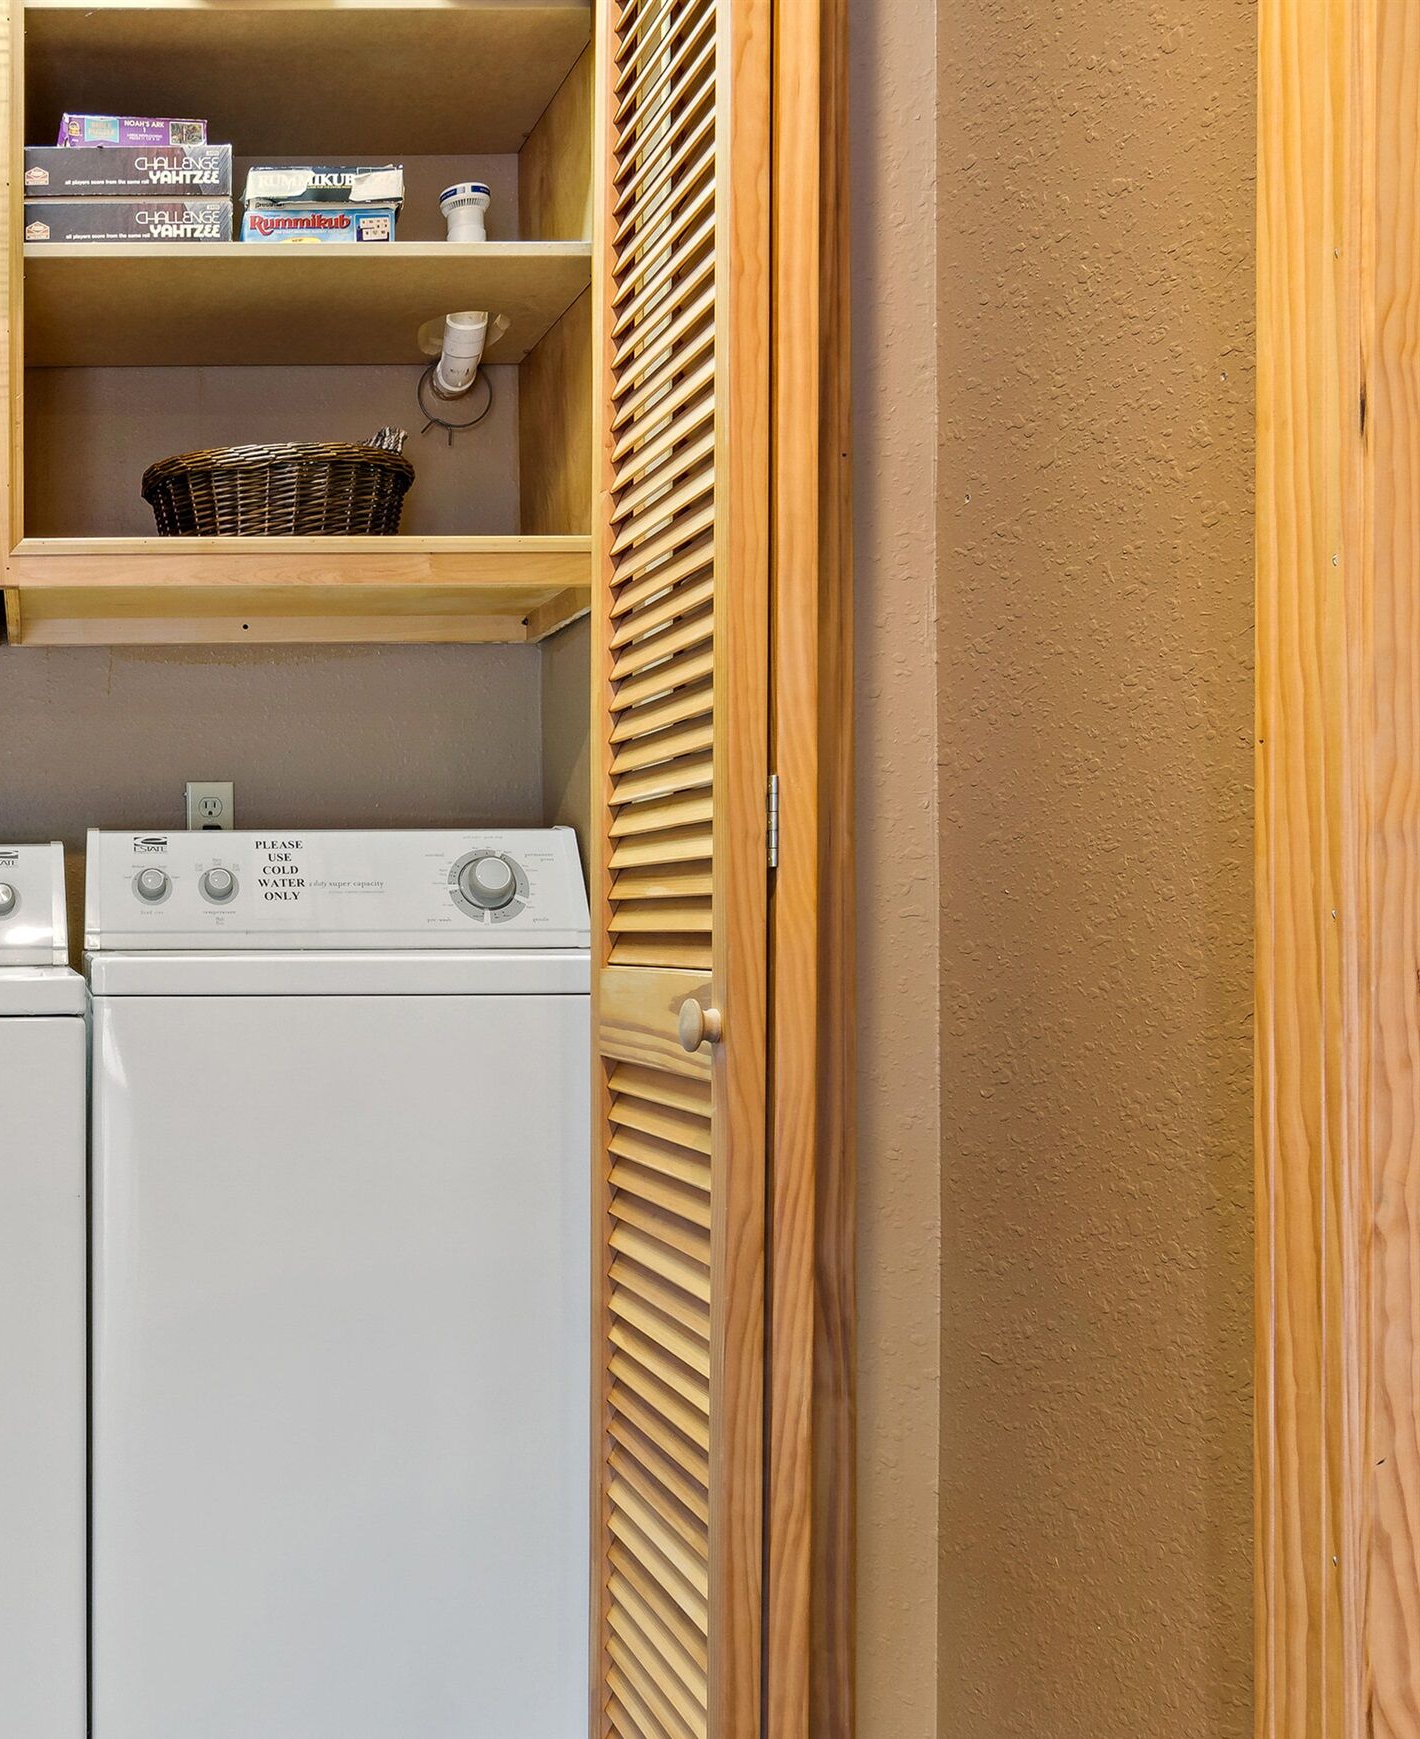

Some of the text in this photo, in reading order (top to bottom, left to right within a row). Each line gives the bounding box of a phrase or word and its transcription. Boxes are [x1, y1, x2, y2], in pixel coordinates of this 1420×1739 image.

[123, 120, 150, 128] NOAH'S
[134, 156, 220, 170] CHALLENGE
[148, 170, 220, 185] YAHTZEE
[135, 211, 221, 225] CHALLENGE
[249, 214, 352, 236] Rummikub
[149, 224, 221, 238] YAHTZEE
[255, 840, 303, 849] PLEASE
[268, 853, 292, 862] USE
[262, 866, 299, 875] COLD
[258, 879, 305, 888] WATER
[264, 892, 300, 901] ONLY
